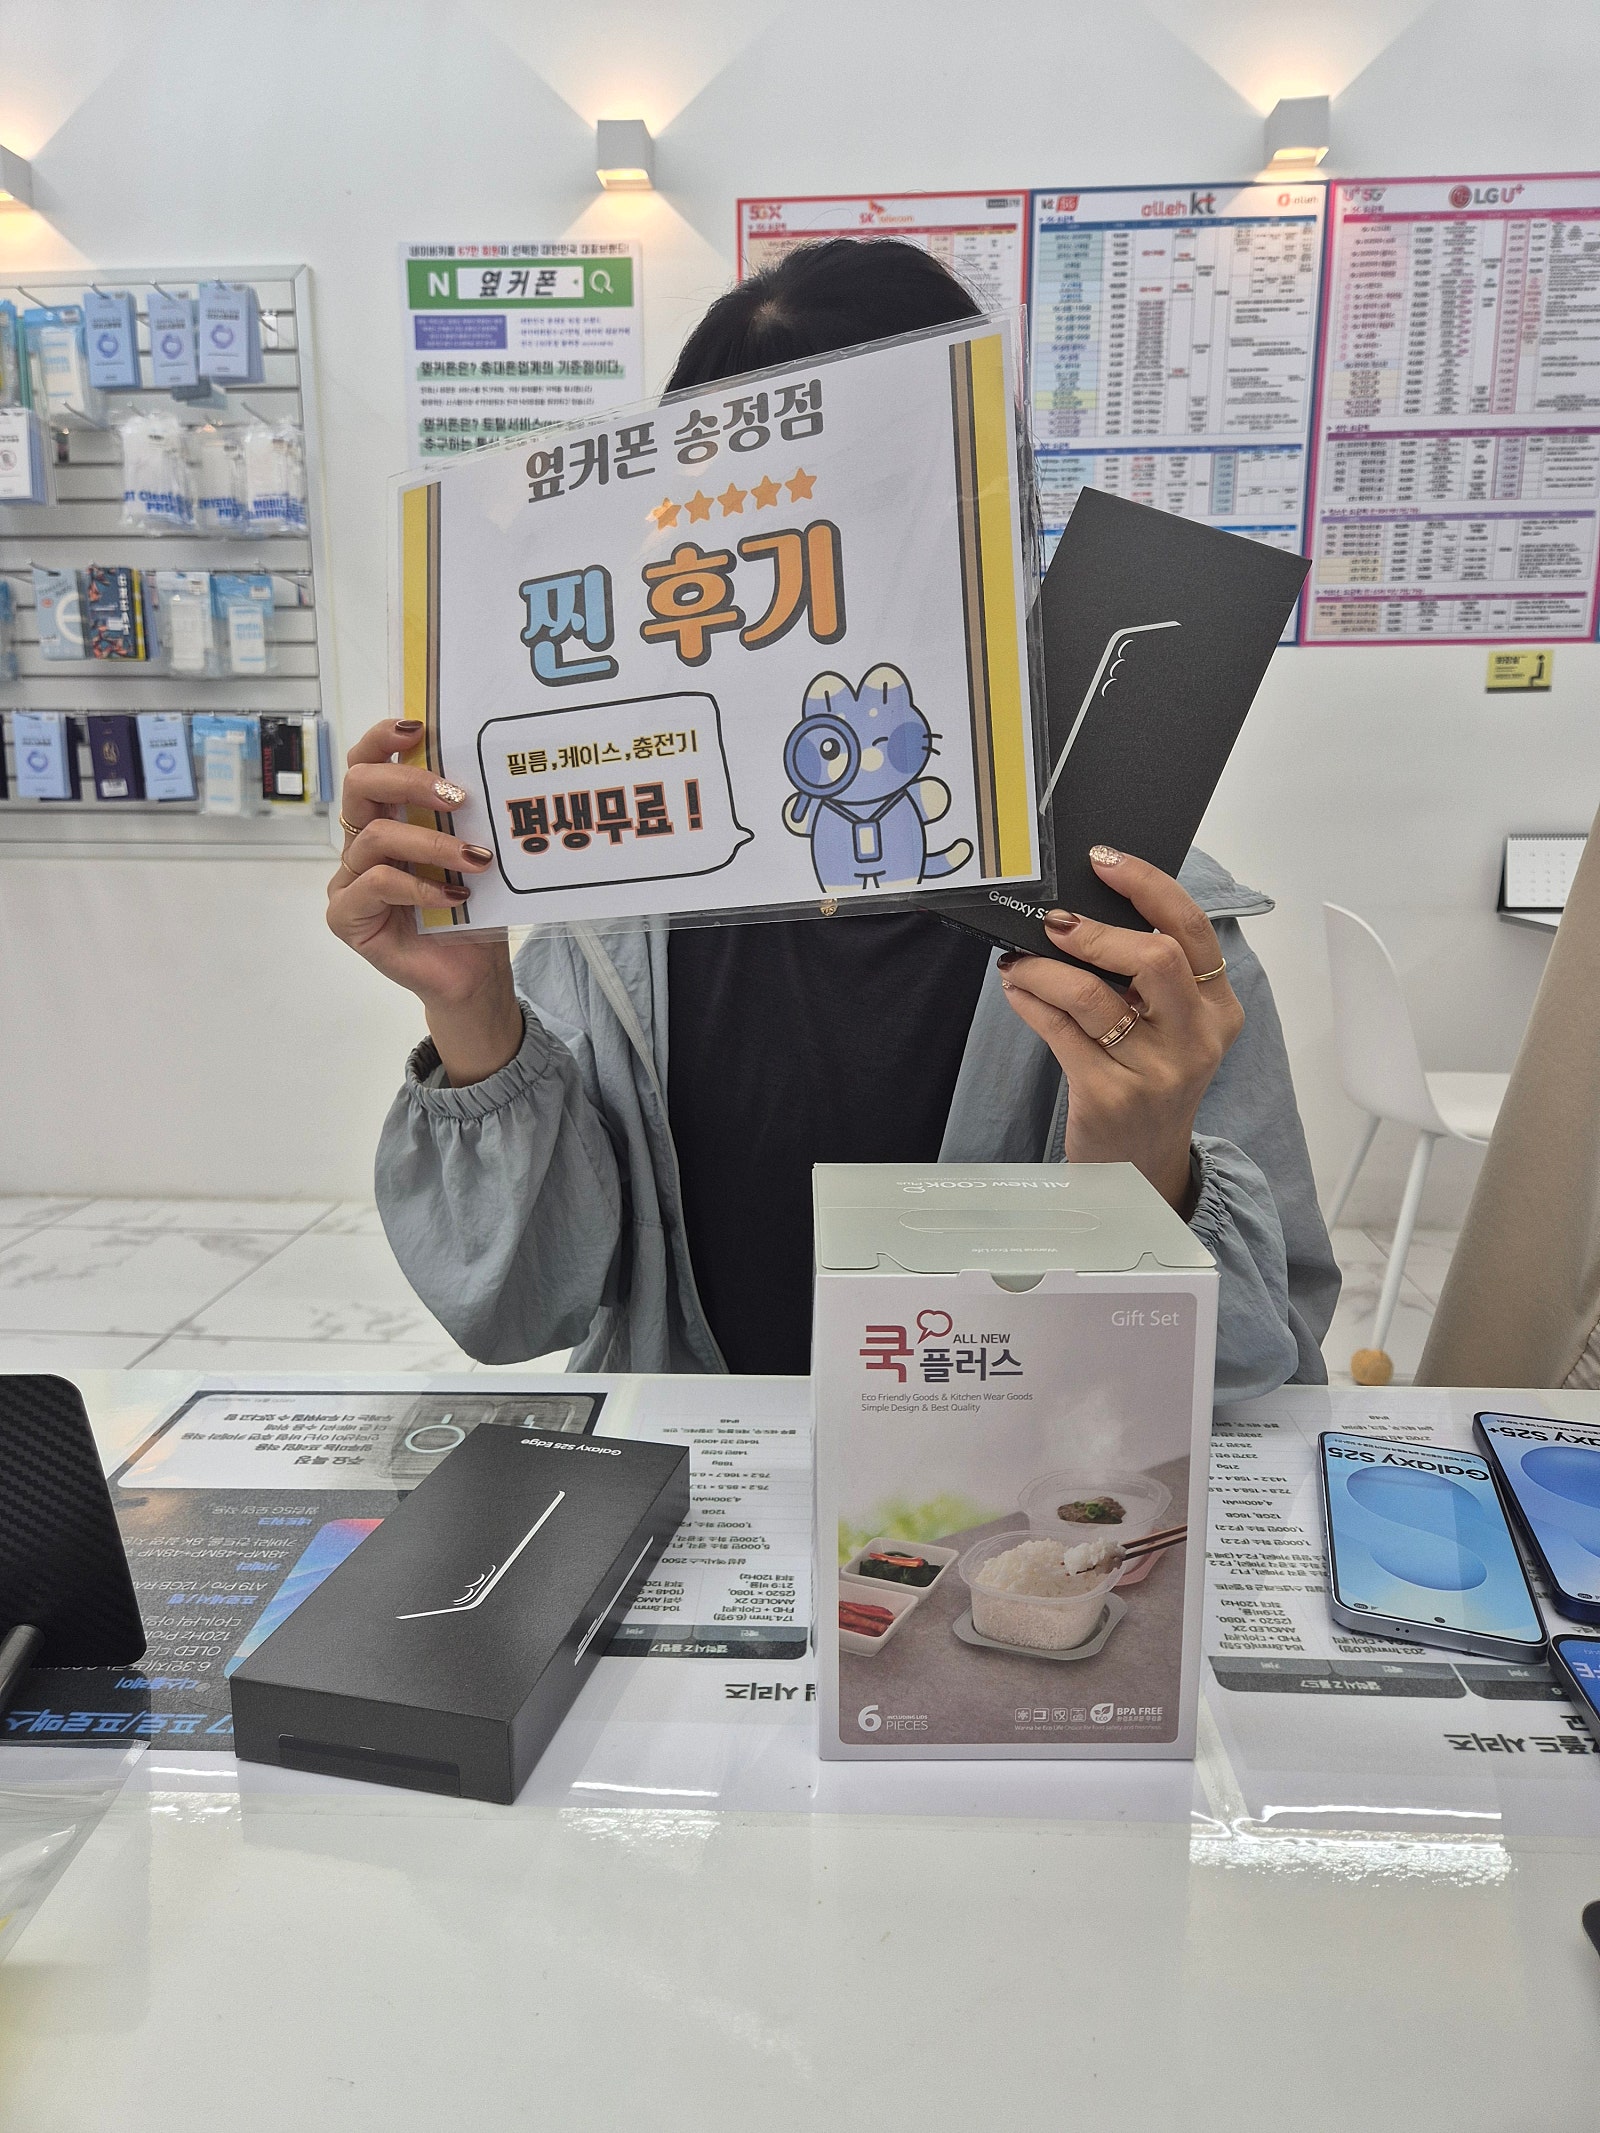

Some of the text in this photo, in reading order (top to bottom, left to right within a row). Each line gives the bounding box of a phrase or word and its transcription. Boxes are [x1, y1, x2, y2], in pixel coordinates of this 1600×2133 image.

[1474, 184, 1524, 204] LG U+
[1190, 192, 1215, 215] kt
[859, 213, 874, 224] SK
[429, 272, 450, 297] N
[527, 378, 825, 504] 옆커폰 송정점
[519, 519, 847, 688] 찐 후기
[507, 730, 699, 776] 필름,케이스,충전기
[505, 783, 675, 855] 평생무료
[989, 891, 1048, 920] Galaxy S
[1111, 1310, 1180, 1327] Gift Set
[953, 1333, 1010, 1344] ALL NEW
[860, 1325, 914, 1383] 쿡
[920, 1347, 1023, 1382] 플러스
[861, 1392, 1034, 1403] Eco Friendly Goods & Kitchen Wear Goods
[861, 1403, 981, 1414] Simple Design & Best Quality
[303, 1433, 329, 1441] 아닌
[1488, 1427, 1548, 1441] S25+
[521, 1438, 554, 1448] Edge
[576, 1444, 622, 1456] Galaxy
[1327, 1446, 1375, 1463] S25
[294, 1455, 364, 1465] 주요 특징
[1381, 1453, 1489, 1482] Galaxy
[1222, 1499, 1273, 1507] 4,400mAh
[1215, 1524, 1244, 1532] (F2.2)
[185, 1537, 298, 1547] 카메라 8K
[1221, 1537, 1250, 1545] (F2.2)
[136, 1548, 290, 1557] 48MP+48MP+48MP
[1236, 1552, 1258, 1560] F2.4
[661, 1557, 688, 1565] 2500
[739, 1573, 773, 1581] 120Hz)
[155, 1581, 268, 1591] A19 Pro 12GB
[655, 1588, 685, 1596] (1048
[728, 1588, 755, 1597] 1080,
[633, 1604, 680, 1612] 104.8mm
[1220, 1599, 1259, 1607] 120Hz)
[177, 1616, 241, 1626] 다이나믹
[749, 1614, 794, 1622] 174.1mm
[1216, 1616, 1292, 1625] (2520 1080,
[181, 1631, 231, 1640] 120Hz
[174, 1646, 221, 1656] OLED
[694, 1644, 729, 1653] 갤럭시
[1219, 1642, 1305, 1651] 164.8mm(6.5형)
[113, 1677, 199, 1690] 디스플레이
[725, 1683, 799, 1702] 시리즈
[1139, 1707, 1163, 1715] FREE
[5, 1709, 207, 1734] 프로/프로맥스
[858, 1704, 882, 1732] 6
[886, 1720, 928, 1731] PIECES
[1443, 1733, 1527, 1752] 시리즈
